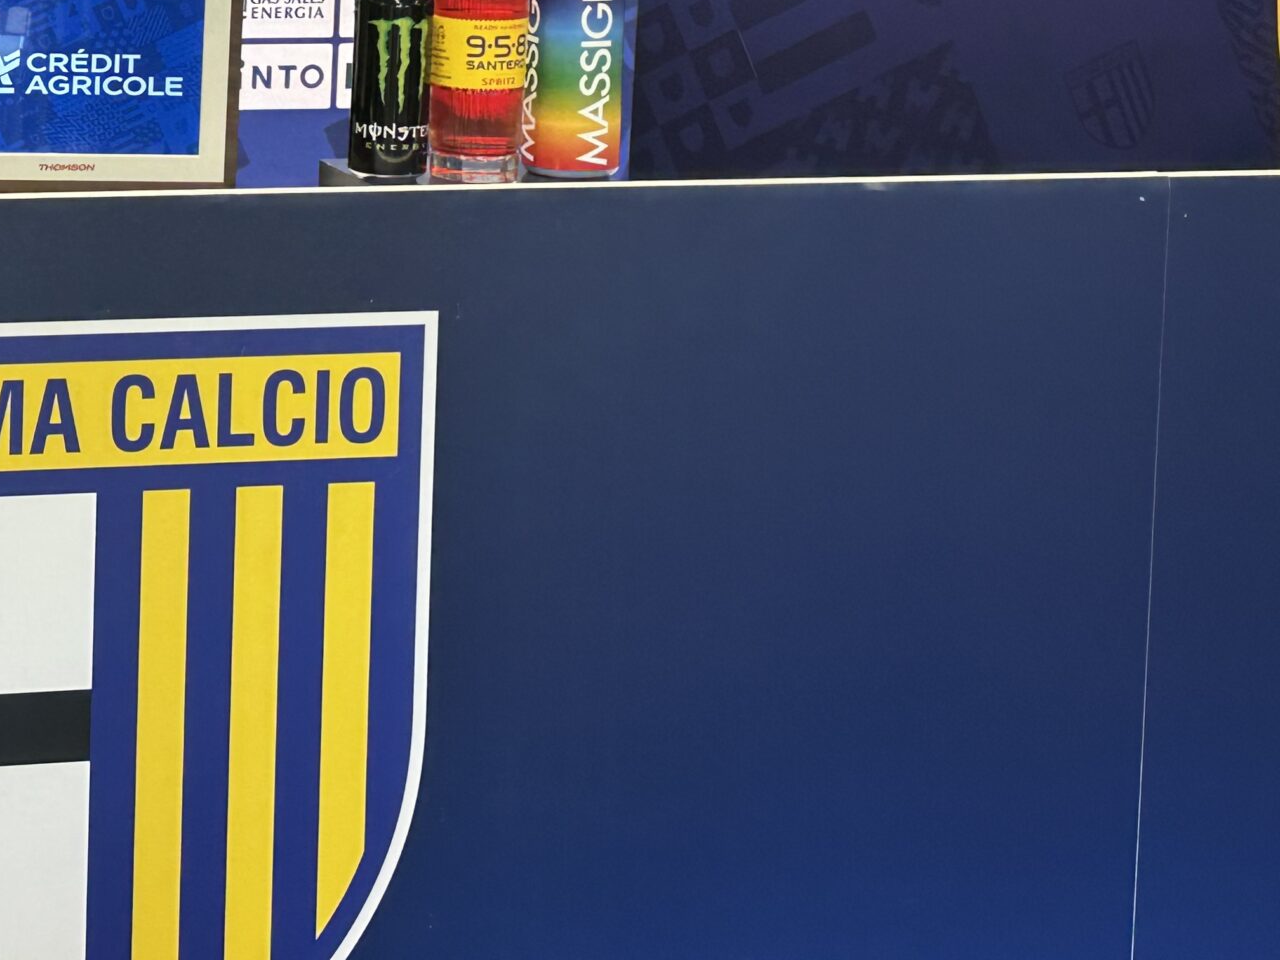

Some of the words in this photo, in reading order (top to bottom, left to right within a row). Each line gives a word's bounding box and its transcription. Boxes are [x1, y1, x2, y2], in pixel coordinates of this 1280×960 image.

[251, 6, 324, 19] ENERGIA
[26, 48, 141, 74] CRÉDIT
[25, 76, 184, 96] AGRICOLE
[39, 164, 96, 172] THOMSON
[111, 366, 386, 453] CALCIO
